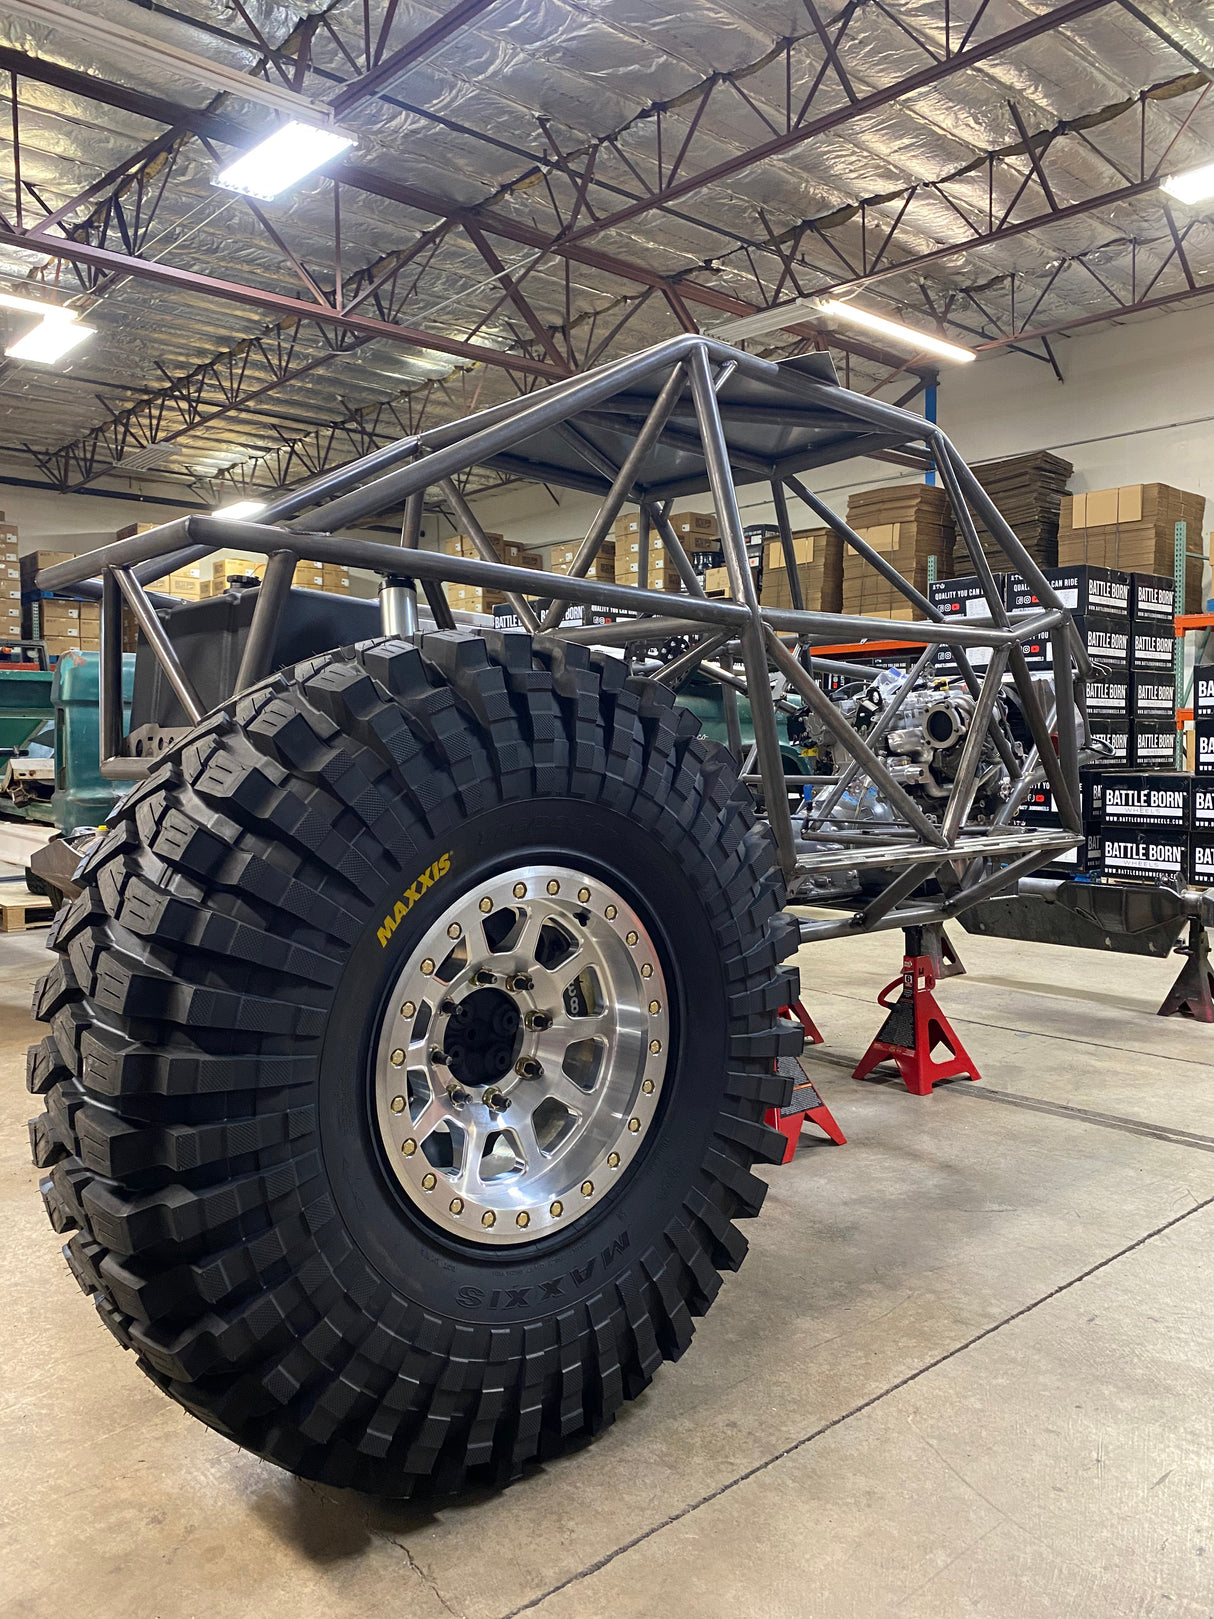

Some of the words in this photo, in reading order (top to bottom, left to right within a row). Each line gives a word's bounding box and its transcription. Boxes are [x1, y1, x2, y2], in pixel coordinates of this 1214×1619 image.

[1051, 580, 1063, 588] CAN
[1064, 578, 1078, 586] RIDE
[1089, 580, 1110, 597] BATTLE
[1112, 584, 1129, 600] BORN
[935, 591, 956, 600] QUALITY
[969, 588, 980, 596] CAN
[1138, 587, 1157, 602] BATTLE
[1159, 590, 1174, 604] BORN
[495, 615, 518, 628] BATTLE
[1088, 631, 1110, 647] BATTLE
[1112, 634, 1128, 649] BORN
[1135, 636, 1156, 651] BATTLE
[1157, 638, 1173, 652] BORN
[1086, 683, 1108, 698] BATTLE
[1110, 684, 1127, 698] BORN
[1138, 685, 1157, 699] BATTLE
[1159, 686, 1174, 699] BORN
[1112, 734, 1128, 748] BORN
[1138, 734, 1157, 748] BATTLE
[1159, 734, 1174, 748] BORN
[1106, 790, 1147, 806] BATTLE
[1151, 791, 1183, 807] BORN
[1105, 842, 1146, 859] BATTLE
[1150, 844, 1181, 862] BORN
[376, 853, 451, 948] MAXXIS
[454, 1230, 630, 1310] MAXXIS
